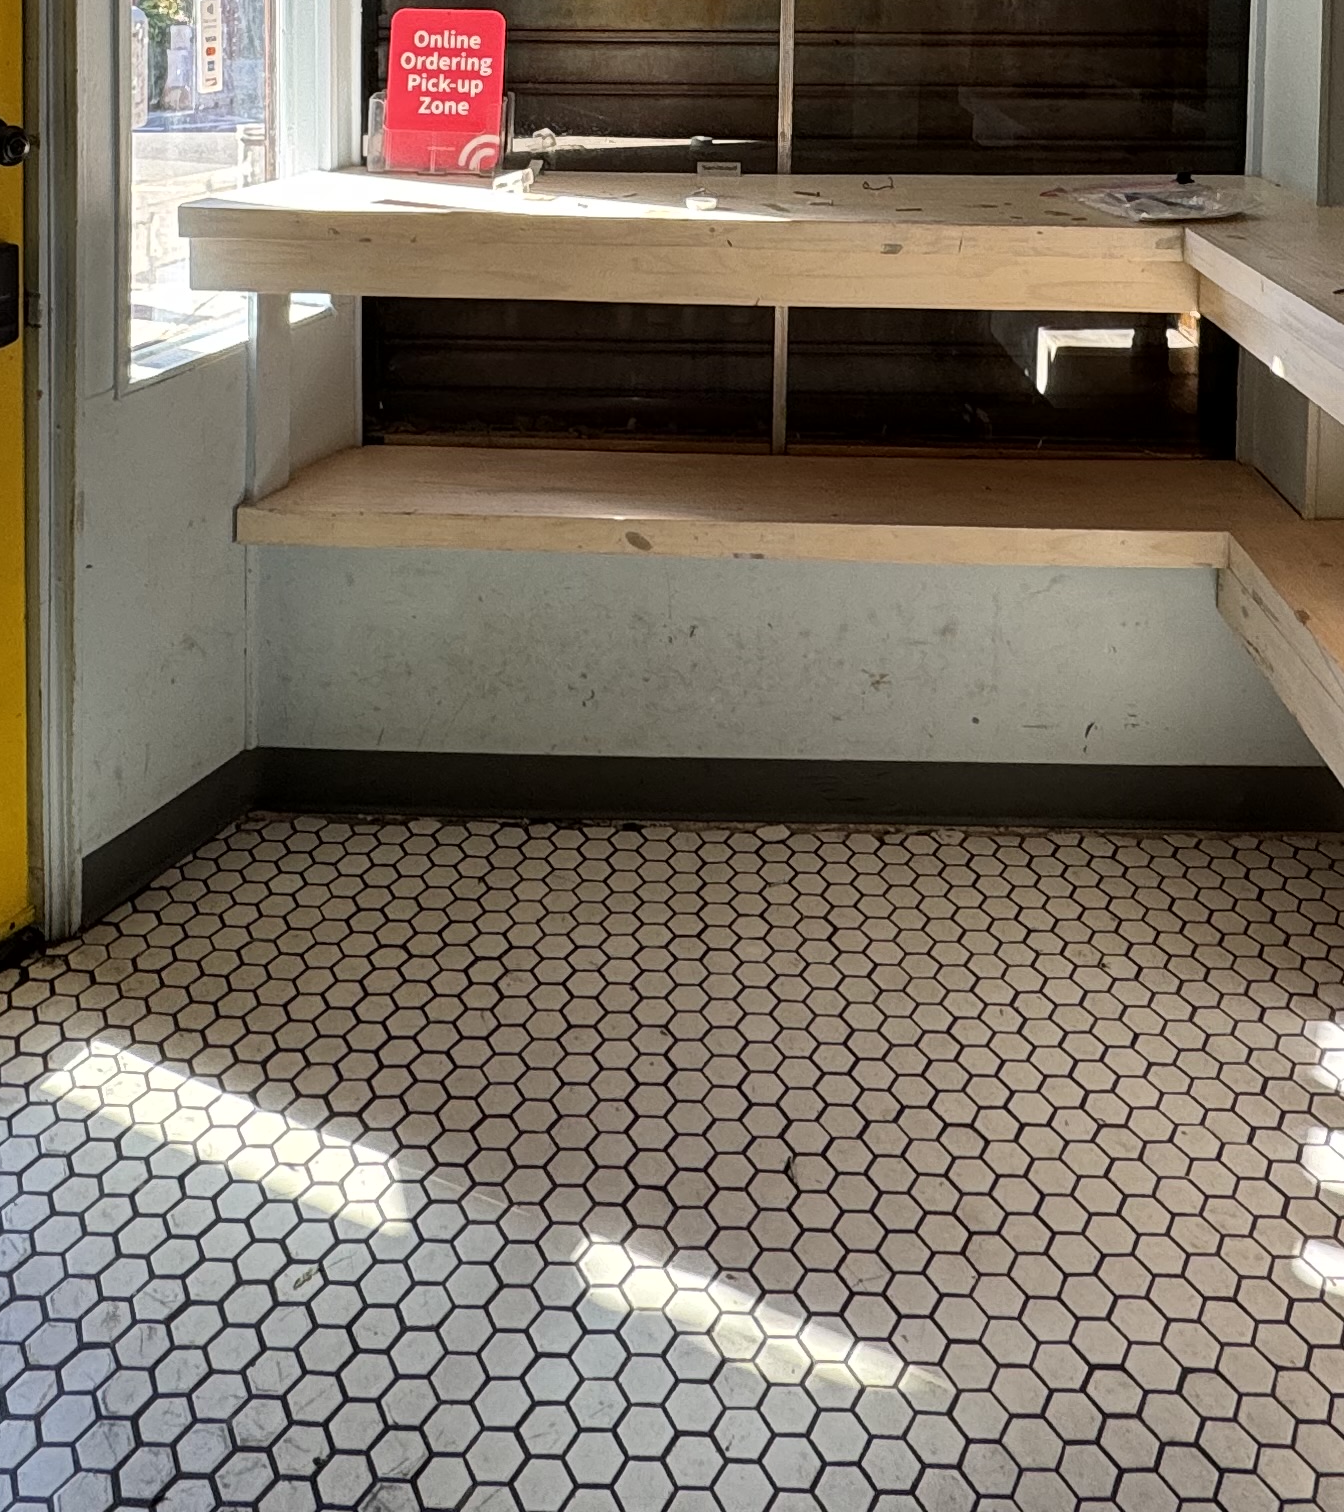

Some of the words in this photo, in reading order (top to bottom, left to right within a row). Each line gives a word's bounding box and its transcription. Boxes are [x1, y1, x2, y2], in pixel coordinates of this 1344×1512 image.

[414, 30, 482, 49] Online
[400, 52, 493, 76] Ordering
[407, 73, 484, 97] Pick-up
[418, 96, 470, 115] Zone
